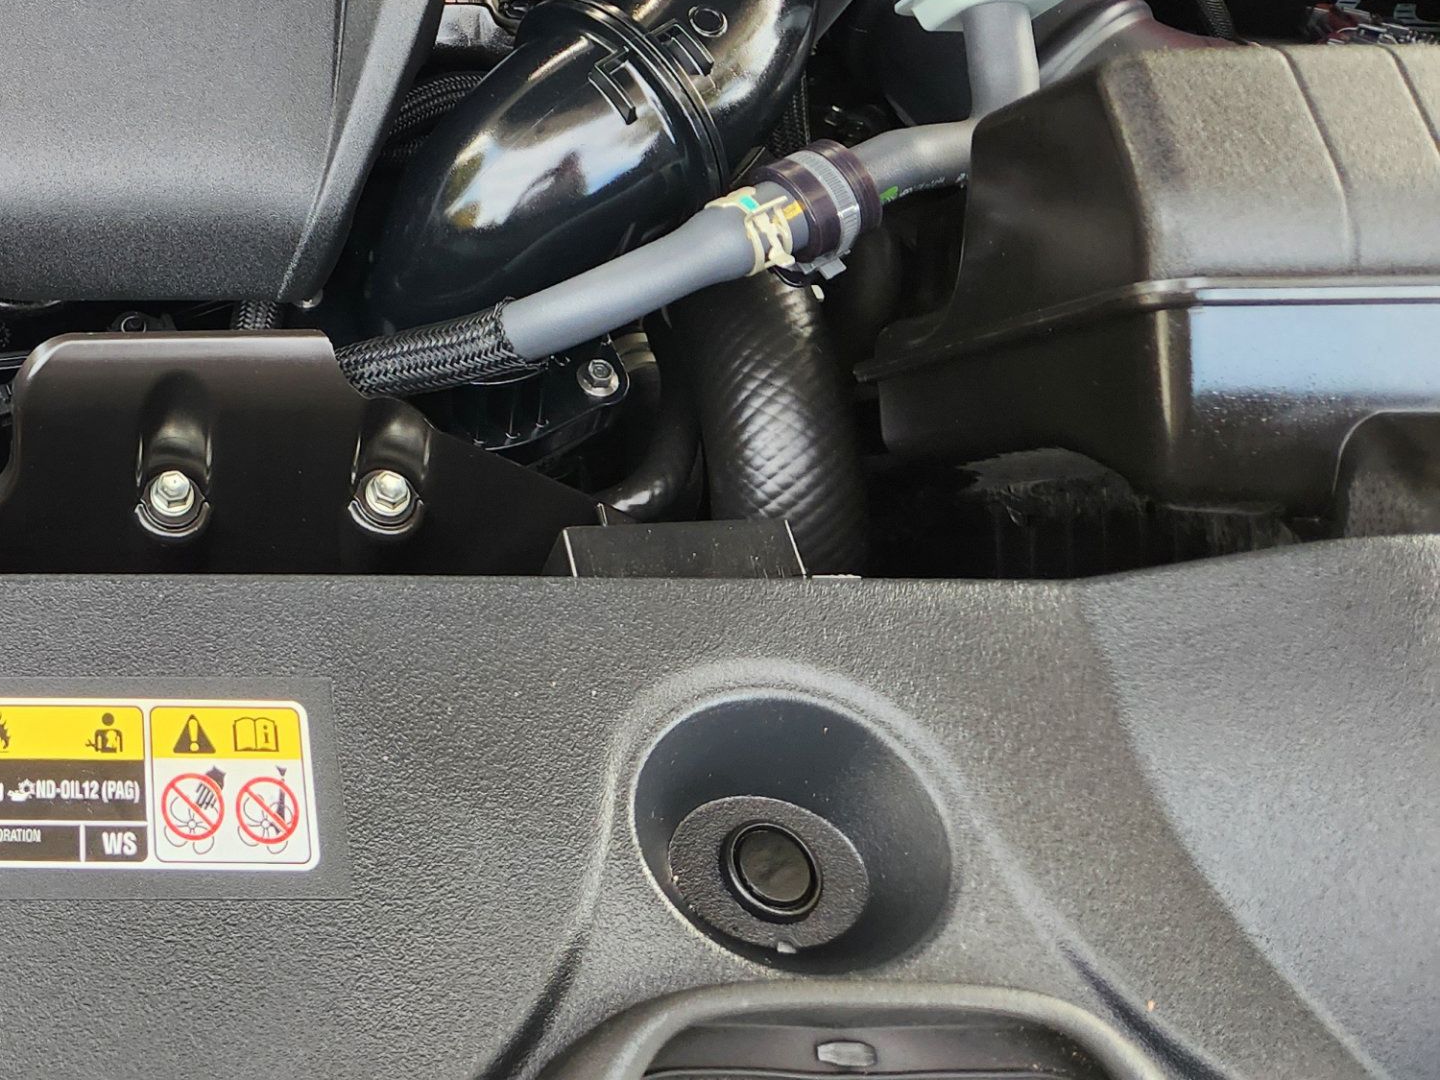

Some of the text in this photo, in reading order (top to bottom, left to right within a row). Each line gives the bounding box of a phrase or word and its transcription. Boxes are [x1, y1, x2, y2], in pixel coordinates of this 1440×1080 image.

[35, 778, 100, 800] ND-OIL12
[101, 779, 141, 804] (PAG)
[101, 831, 138, 856] WS
